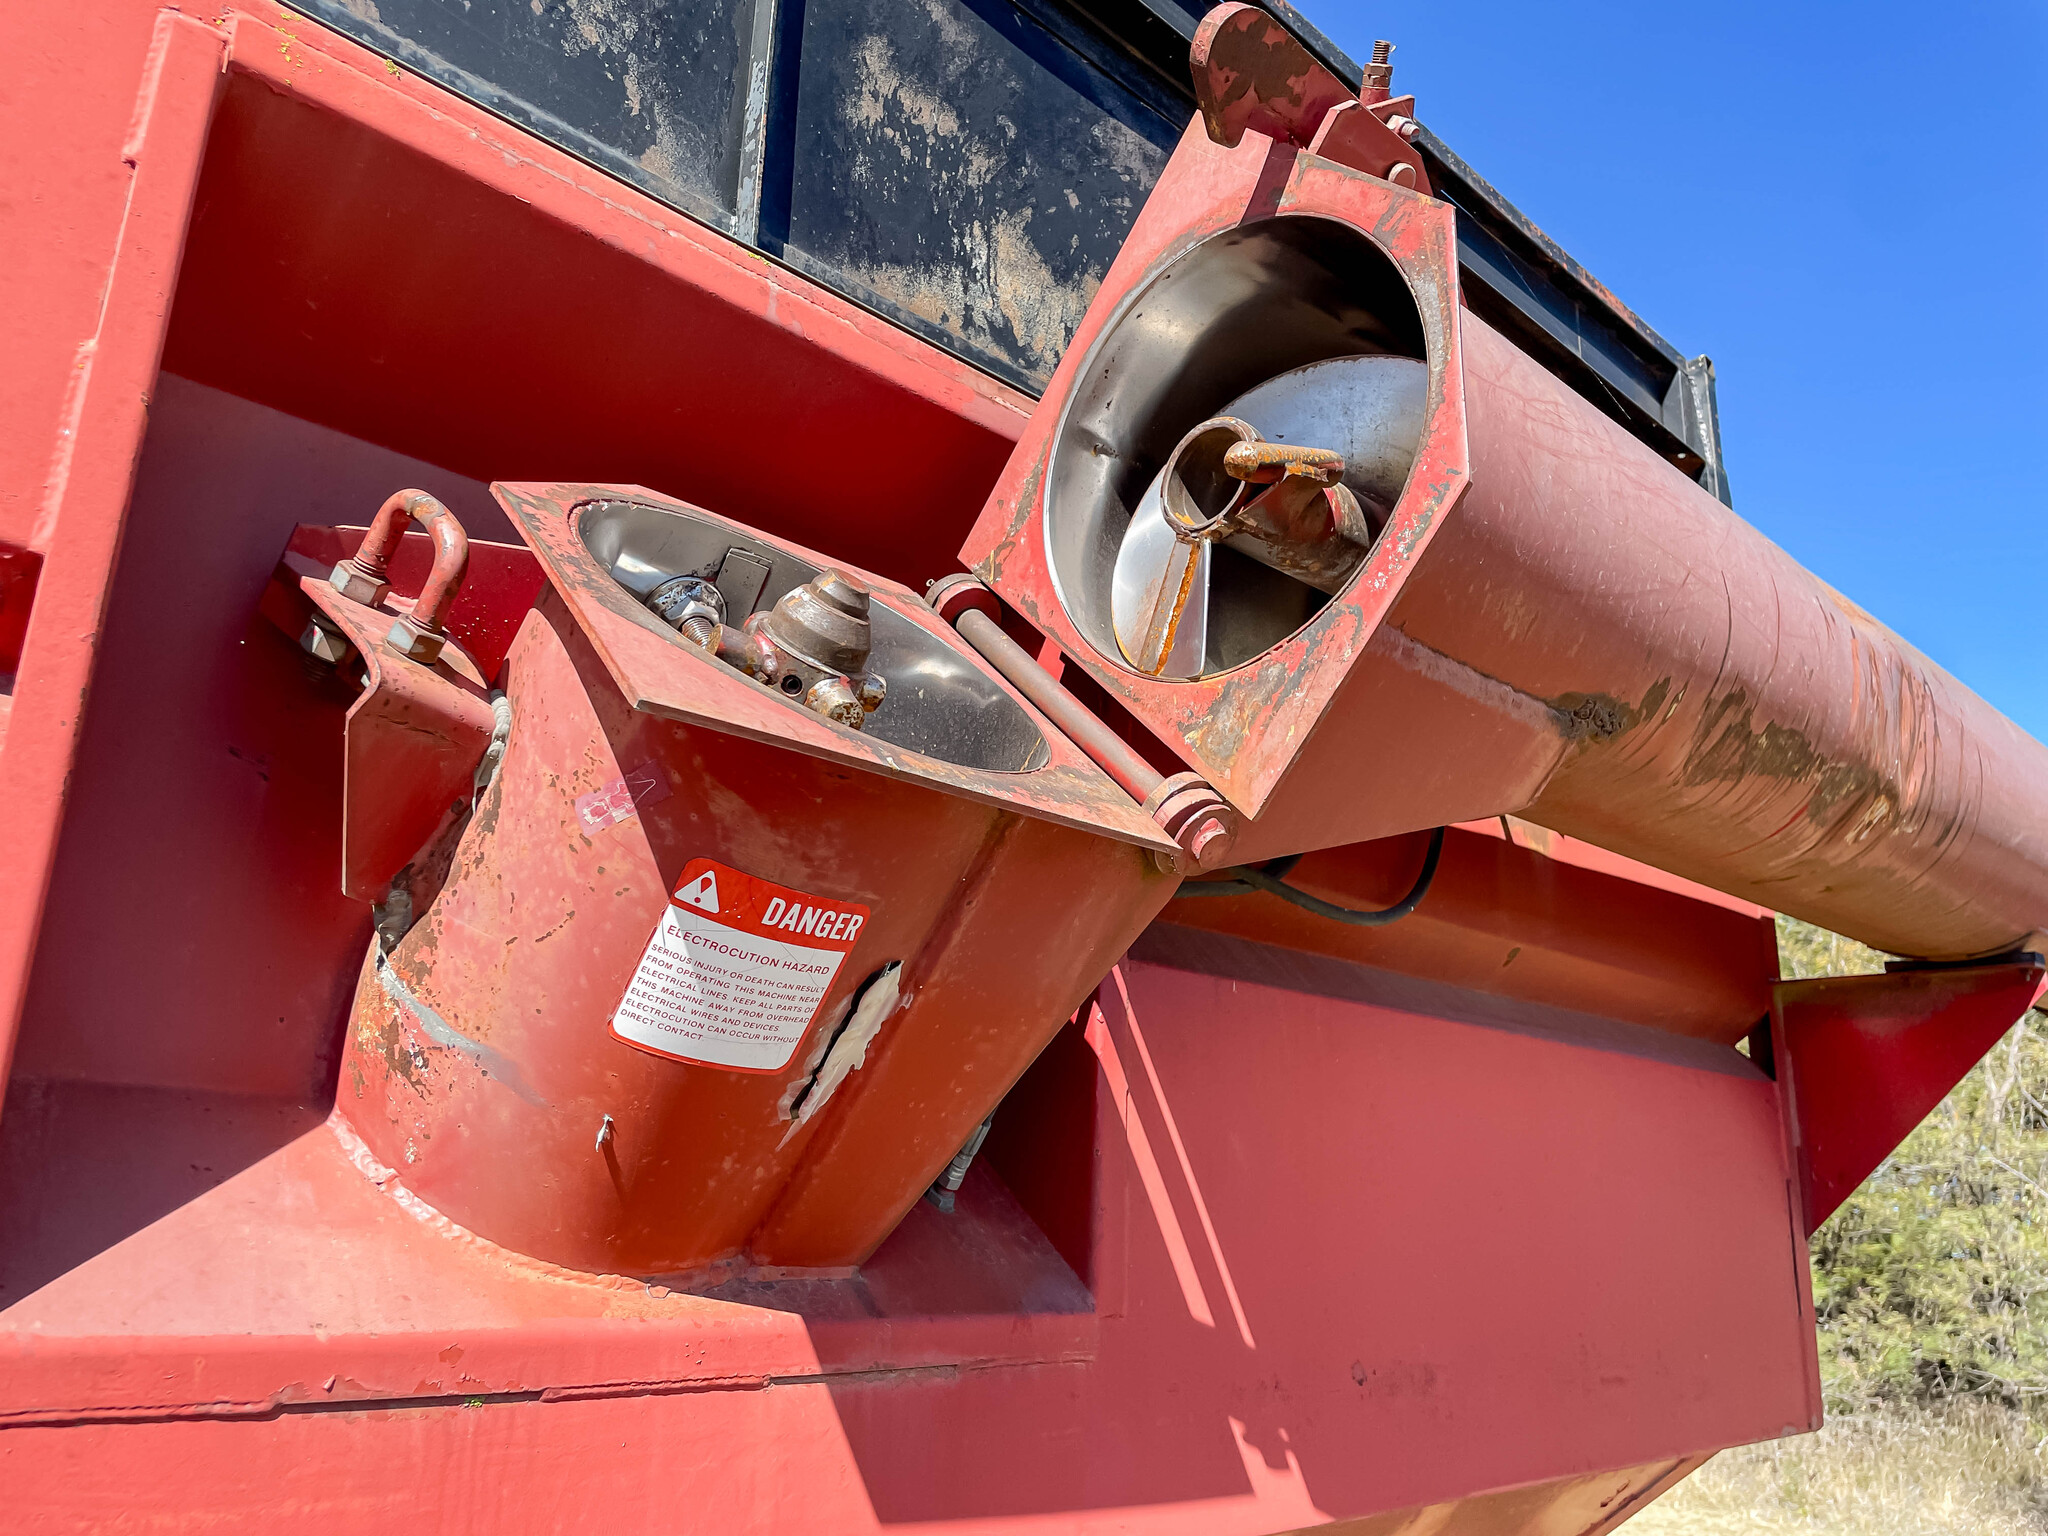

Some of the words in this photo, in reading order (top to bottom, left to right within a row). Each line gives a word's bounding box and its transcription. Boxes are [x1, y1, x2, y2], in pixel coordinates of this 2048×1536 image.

[761, 897, 863, 941] DANGER
[651, 944, 693, 965] SERIOUS
[694, 960, 729, 976] INJURY
[730, 971, 743, 981] OR
[744, 975, 775, 987] DEATH
[776, 981, 794, 990] CAN
[795, 984, 825, 993] RESULT
[667, 925, 780, 968] ELECTROCUTION
[782, 961, 830, 975] HAZARD
[637, 976, 658, 990] THIS
[661, 986, 705, 1006] MACHINE
[708, 1002, 735, 1013] AWAY
[738, 1008, 764, 1019] FROM
[766, 1014, 809, 1024] OVERHEAD
[641, 966, 697, 992] ELECTRICAL
[732, 996, 757, 1007] KEEP
[758, 1001, 773, 1010] ALL
[776, 1004, 802, 1013] PARTS
[646, 955, 673, 970] FROM
[676, 967, 730, 989] OPERATING
[735, 984, 755, 995] THIS
[757, 990, 797, 1002] MACHINE
[620, 1008, 656, 1026] DIRECT
[625, 998, 705, 1030] ELECTROCUTION
[707, 1025, 727, 1035] CAN
[729, 1029, 761, 1040] OCCUR
[763, 1035, 800, 1043] WITHOUT
[630, 987, 687, 1013] ELECTRICAL
[691, 1008, 719, 1022] WIRES
[722, 1017, 741, 1026] AND
